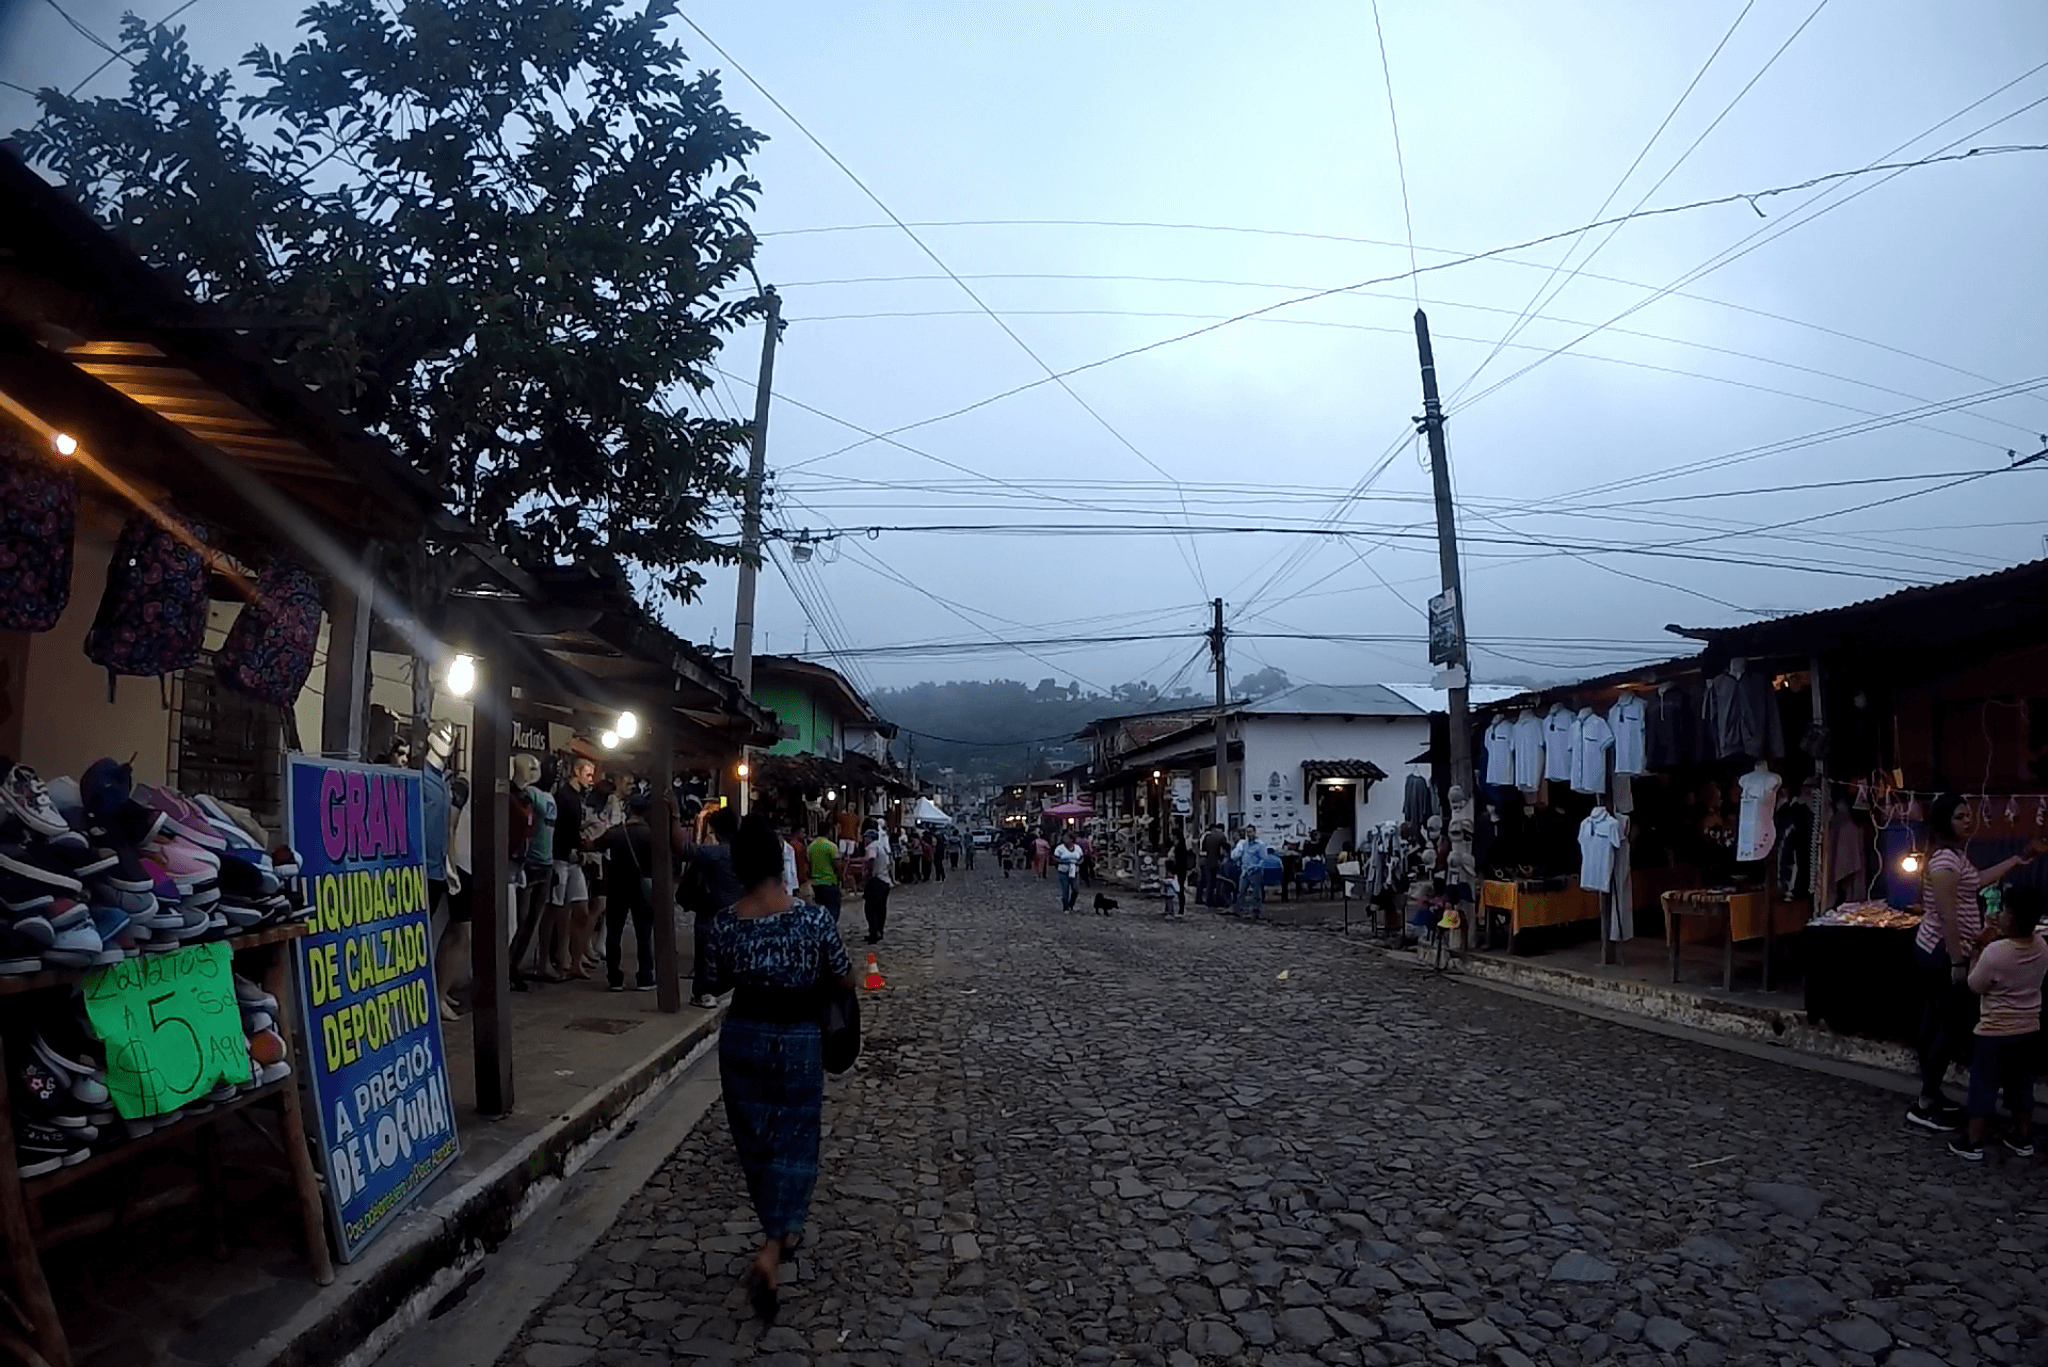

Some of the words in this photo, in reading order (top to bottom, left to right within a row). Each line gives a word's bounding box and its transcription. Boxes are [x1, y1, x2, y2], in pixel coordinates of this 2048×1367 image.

[320, 767, 408, 863] GRAN
[302, 865, 427, 935] LIQUIDACION
[308, 942, 342, 1007] DE
[344, 921, 427, 993] CALZADO
[322, 978, 429, 1073] DEPORTIVO
[336, 1100, 355, 1144] A
[354, 1036, 433, 1125] PRECIOS
[331, 1135, 366, 1206] DE
